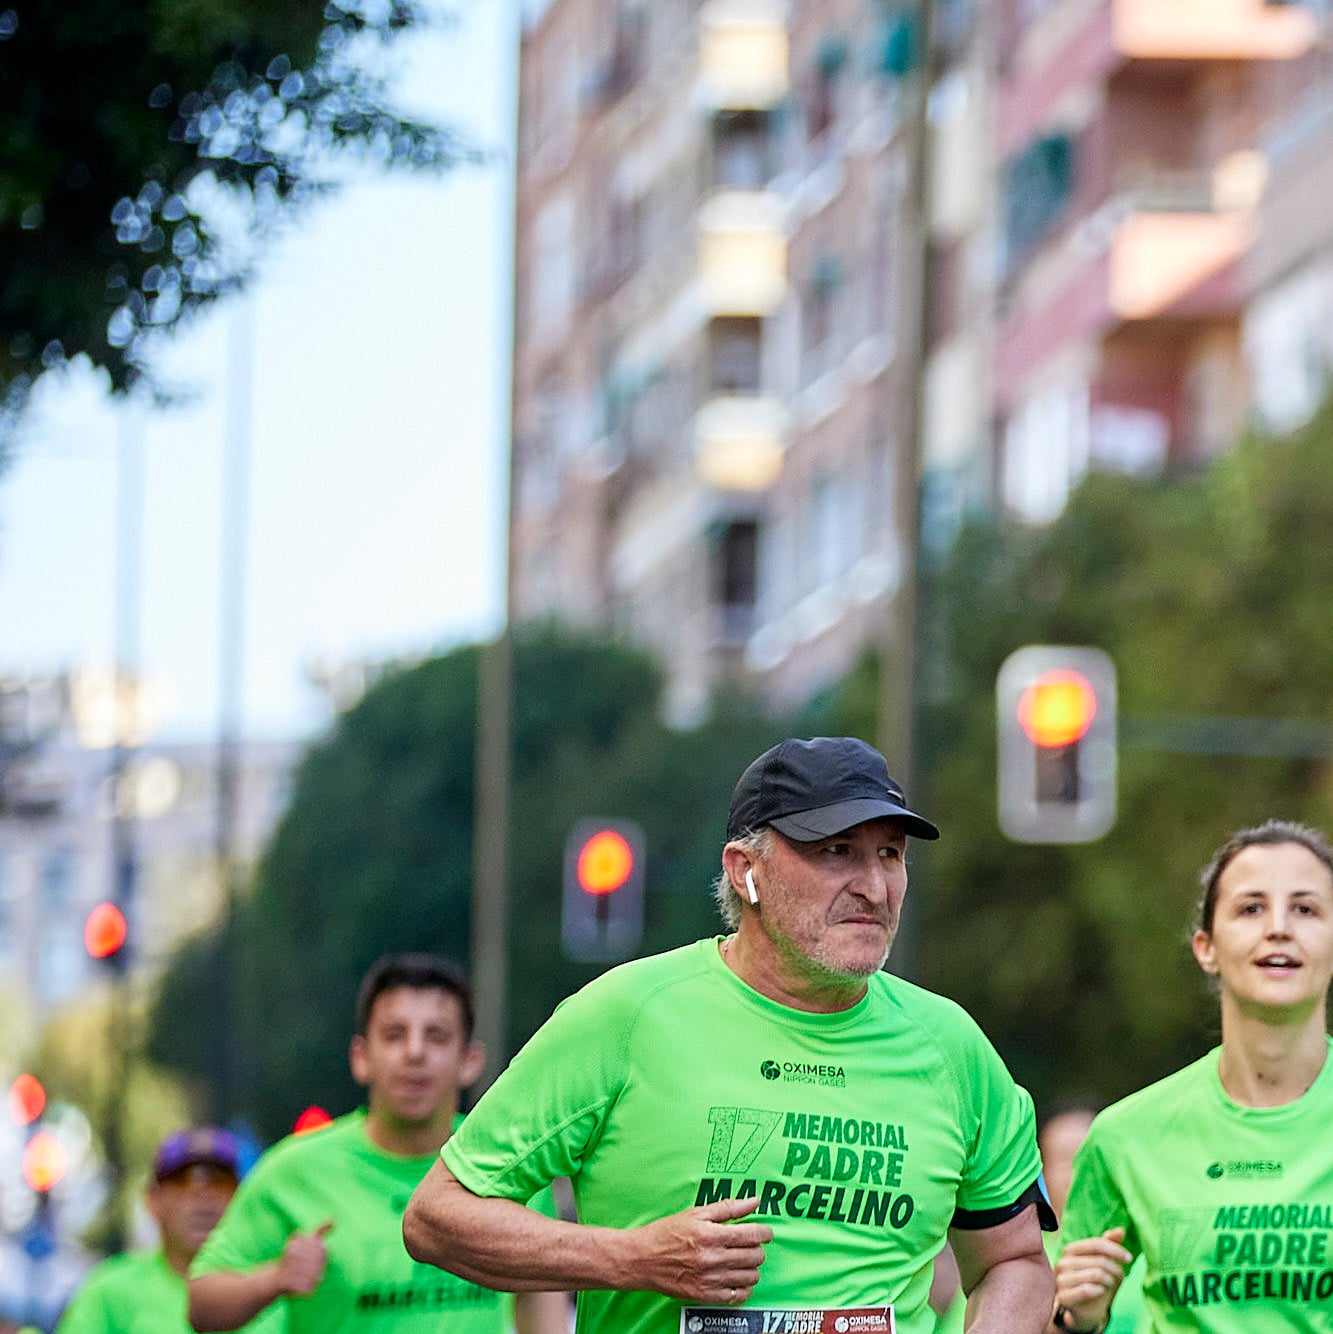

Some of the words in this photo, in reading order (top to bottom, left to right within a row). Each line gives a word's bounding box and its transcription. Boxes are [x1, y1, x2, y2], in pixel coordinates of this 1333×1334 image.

[783, 1062, 846, 1078] OXIMESA
[783, 1075, 816, 1086] NIPPON
[818, 1078, 847, 1089] GASES
[706, 1106, 784, 1174] 17
[782, 1112, 909, 1152] MEMORIAL
[781, 1142, 904, 1188] PADRE
[694, 1178, 914, 1229] MARCELINO
[1213, 1204, 1333, 1230] MEMORIAL
[1215, 1233, 1328, 1266] PADRE
[704, 1316, 749, 1327] OXIMESA
[762, 1311, 785, 1334] 17
[784, 1311, 824, 1322] MEMORIAL
[849, 1316, 887, 1325] OXIMESA
[784, 1321, 821, 1333] PADRE
